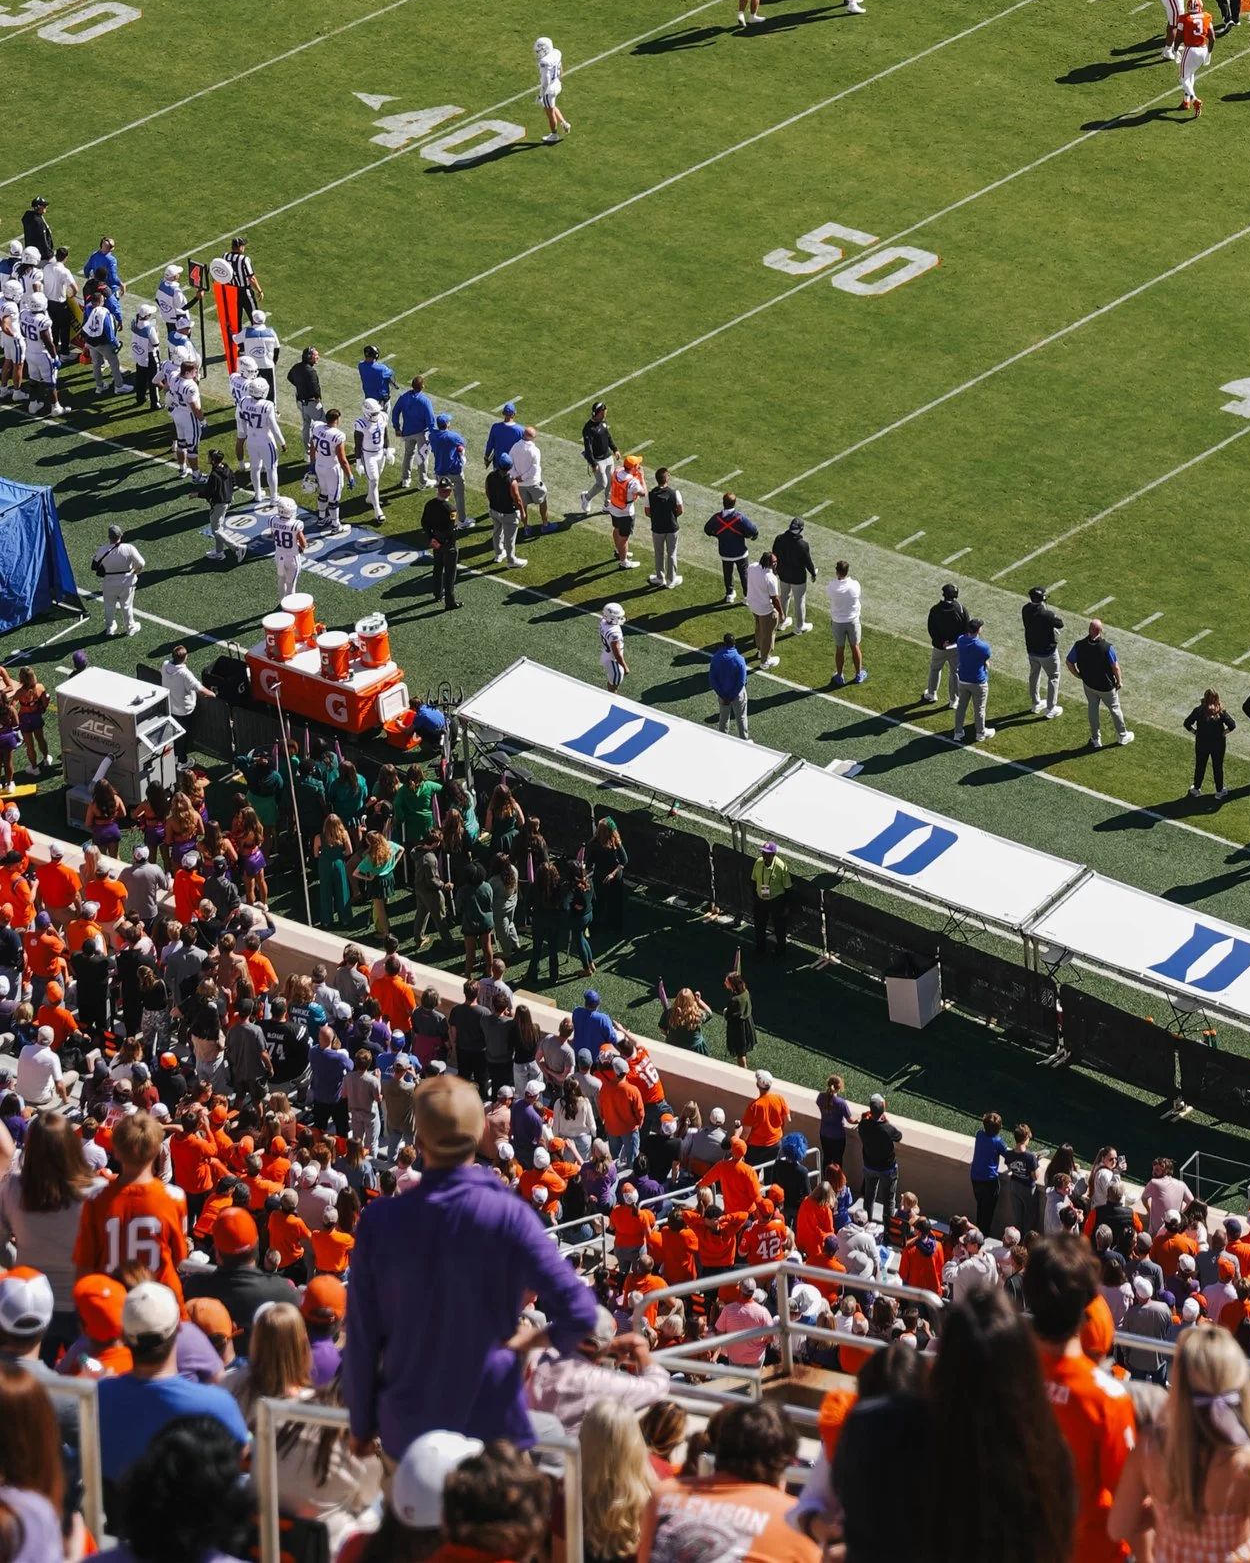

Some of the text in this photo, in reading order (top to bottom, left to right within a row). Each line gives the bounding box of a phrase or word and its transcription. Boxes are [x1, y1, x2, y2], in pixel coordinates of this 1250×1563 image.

[1192, 19, 1203, 35] 3
[371, 103, 525, 167] 40
[763, 222, 939, 296] 50
[190, 266, 200, 285] 4
[20, 322, 38, 341] 76
[313, 436, 331, 455] 79
[231, 516, 250, 527] 10
[273, 530, 293, 549] 48
[266, 635, 276, 646] G
[358, 640, 367, 652] G
[321, 653, 330, 665] G
[237, 682, 246, 694] G
[259, 668, 281, 698] G
[325, 693, 349, 723] G
[79, 719, 115, 737] ACC
[561, 704, 670, 765] D
[847, 809, 959, 876] D
[267, 1041, 286, 1060] 74
[639, 1061, 659, 1089] 16
[105, 1216, 162, 1275] 16
[756, 1238, 780, 1259] 42
[656, 1493, 771, 1536] CLEMSON
